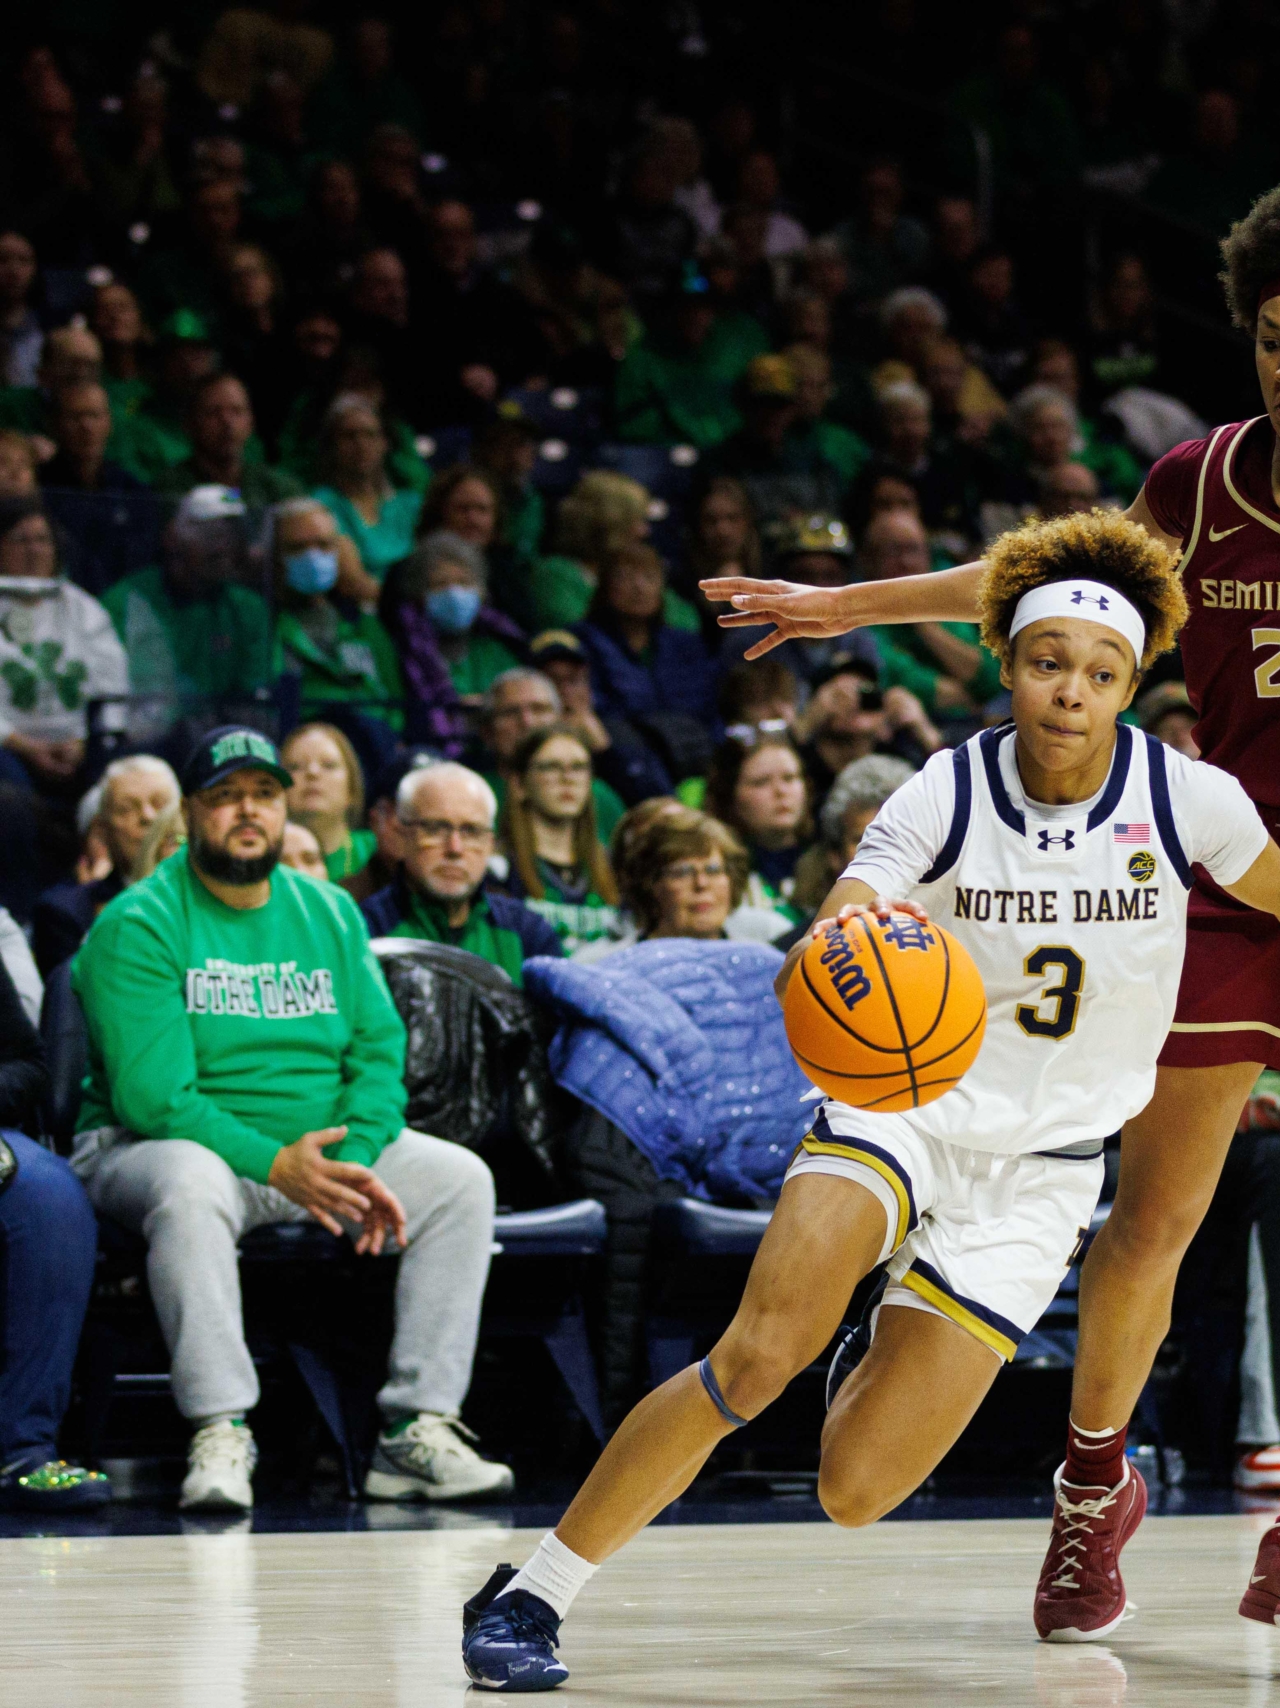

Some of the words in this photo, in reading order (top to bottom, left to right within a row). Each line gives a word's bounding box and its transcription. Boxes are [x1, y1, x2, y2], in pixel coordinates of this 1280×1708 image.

[1130, 859, 1156, 870] ACC
[953, 886, 1059, 924] NOTRE
[1073, 886, 1160, 922] DAME
[820, 925, 873, 1012] Wilso
[1014, 944, 1086, 1042] 3
